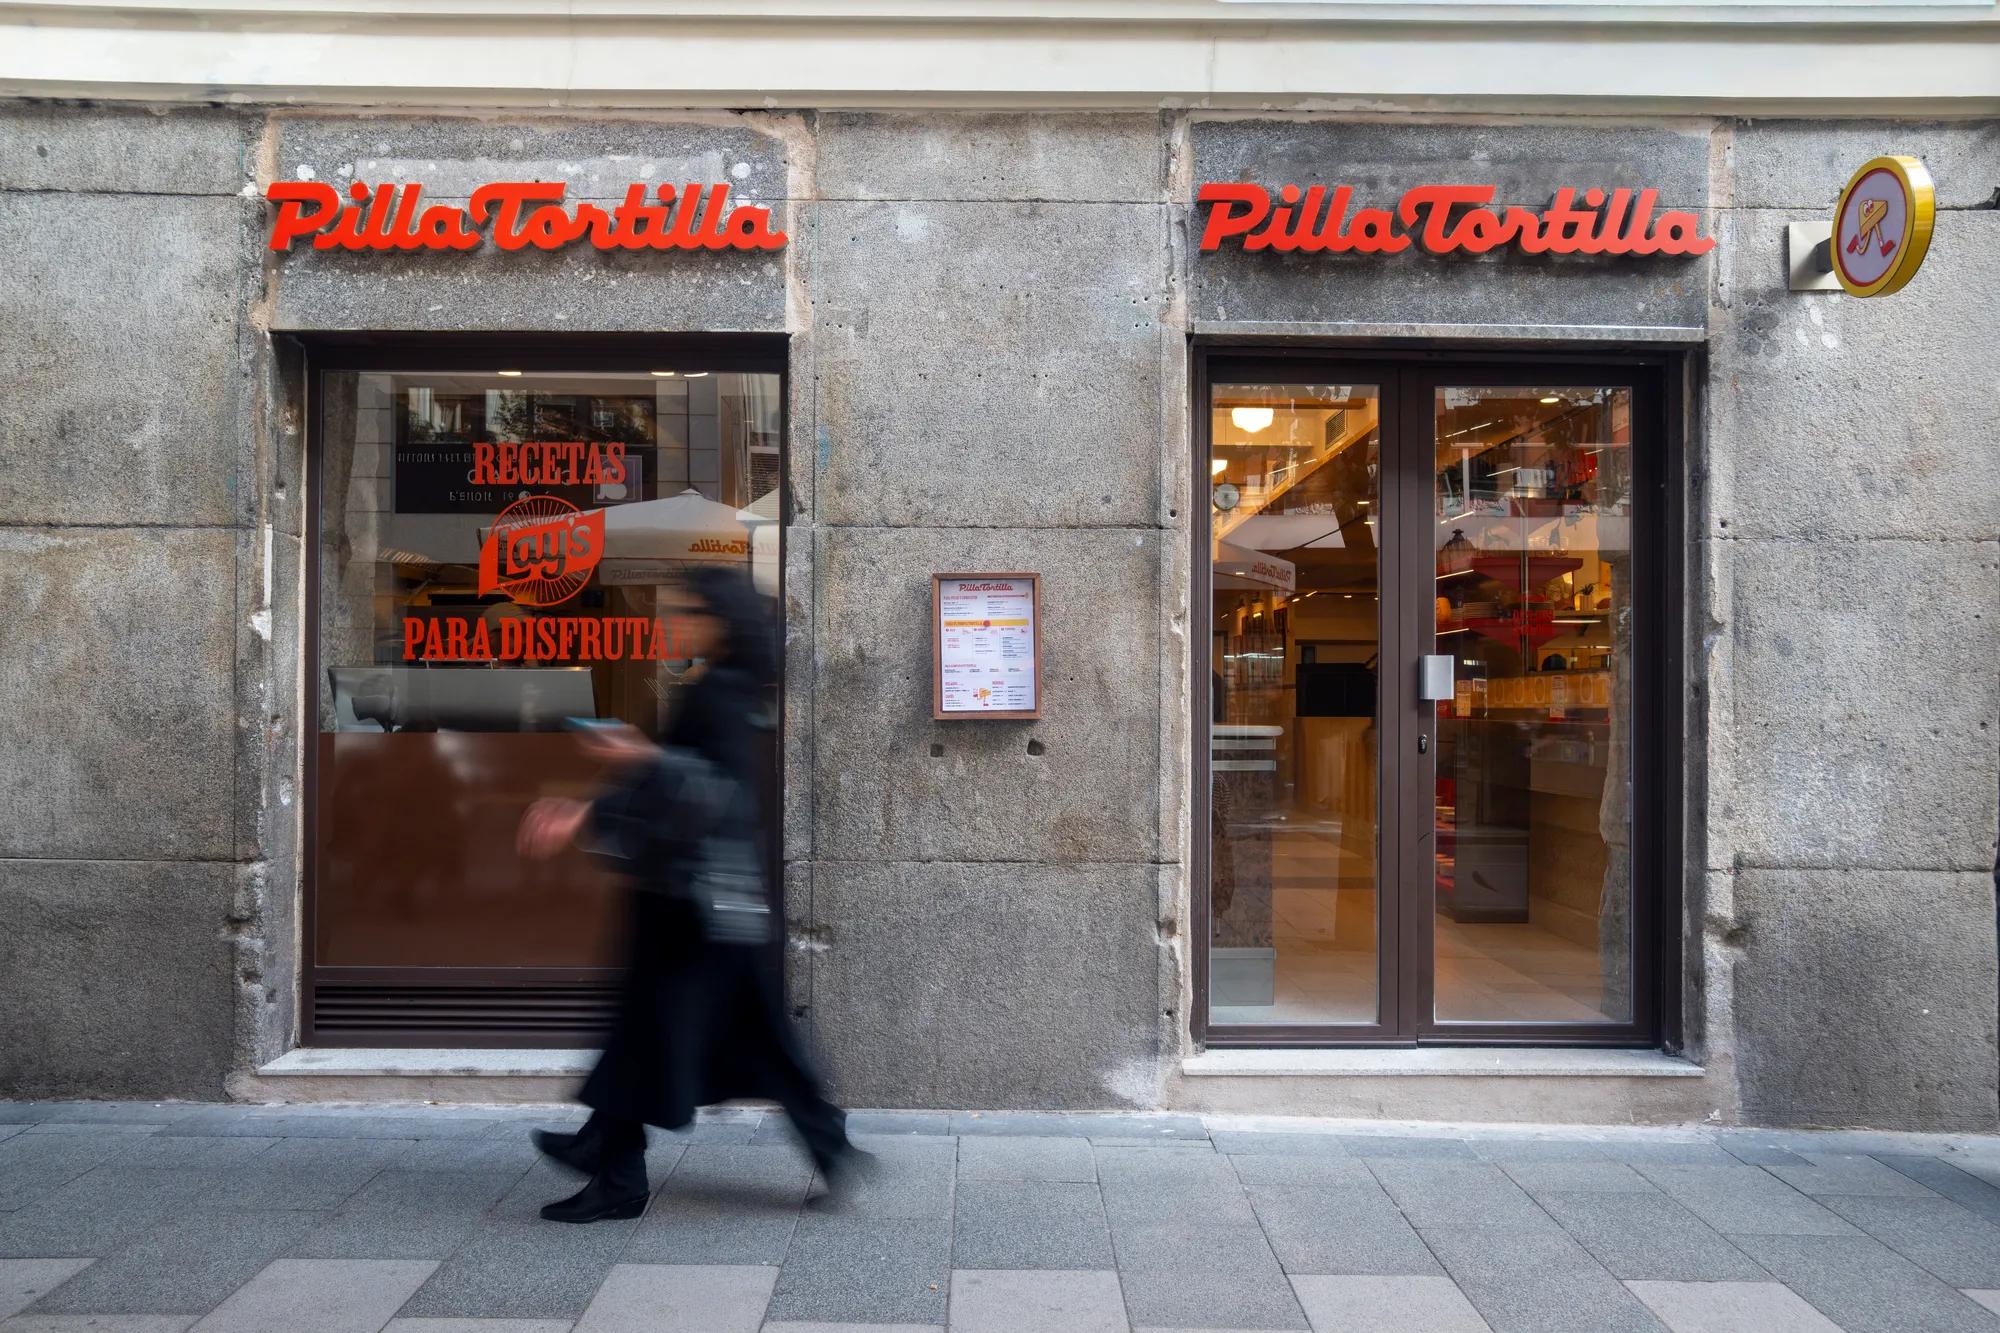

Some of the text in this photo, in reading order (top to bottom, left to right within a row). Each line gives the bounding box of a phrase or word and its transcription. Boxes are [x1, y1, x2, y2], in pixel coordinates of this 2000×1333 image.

[265, 182, 789, 251] Pilla Tortilla
[1199, 183, 1716, 257] Pilla Tortilla
[473, 442, 626, 485] RECETAS
[497, 516, 591, 580] Lay's
[402, 617, 493, 661] PARA
